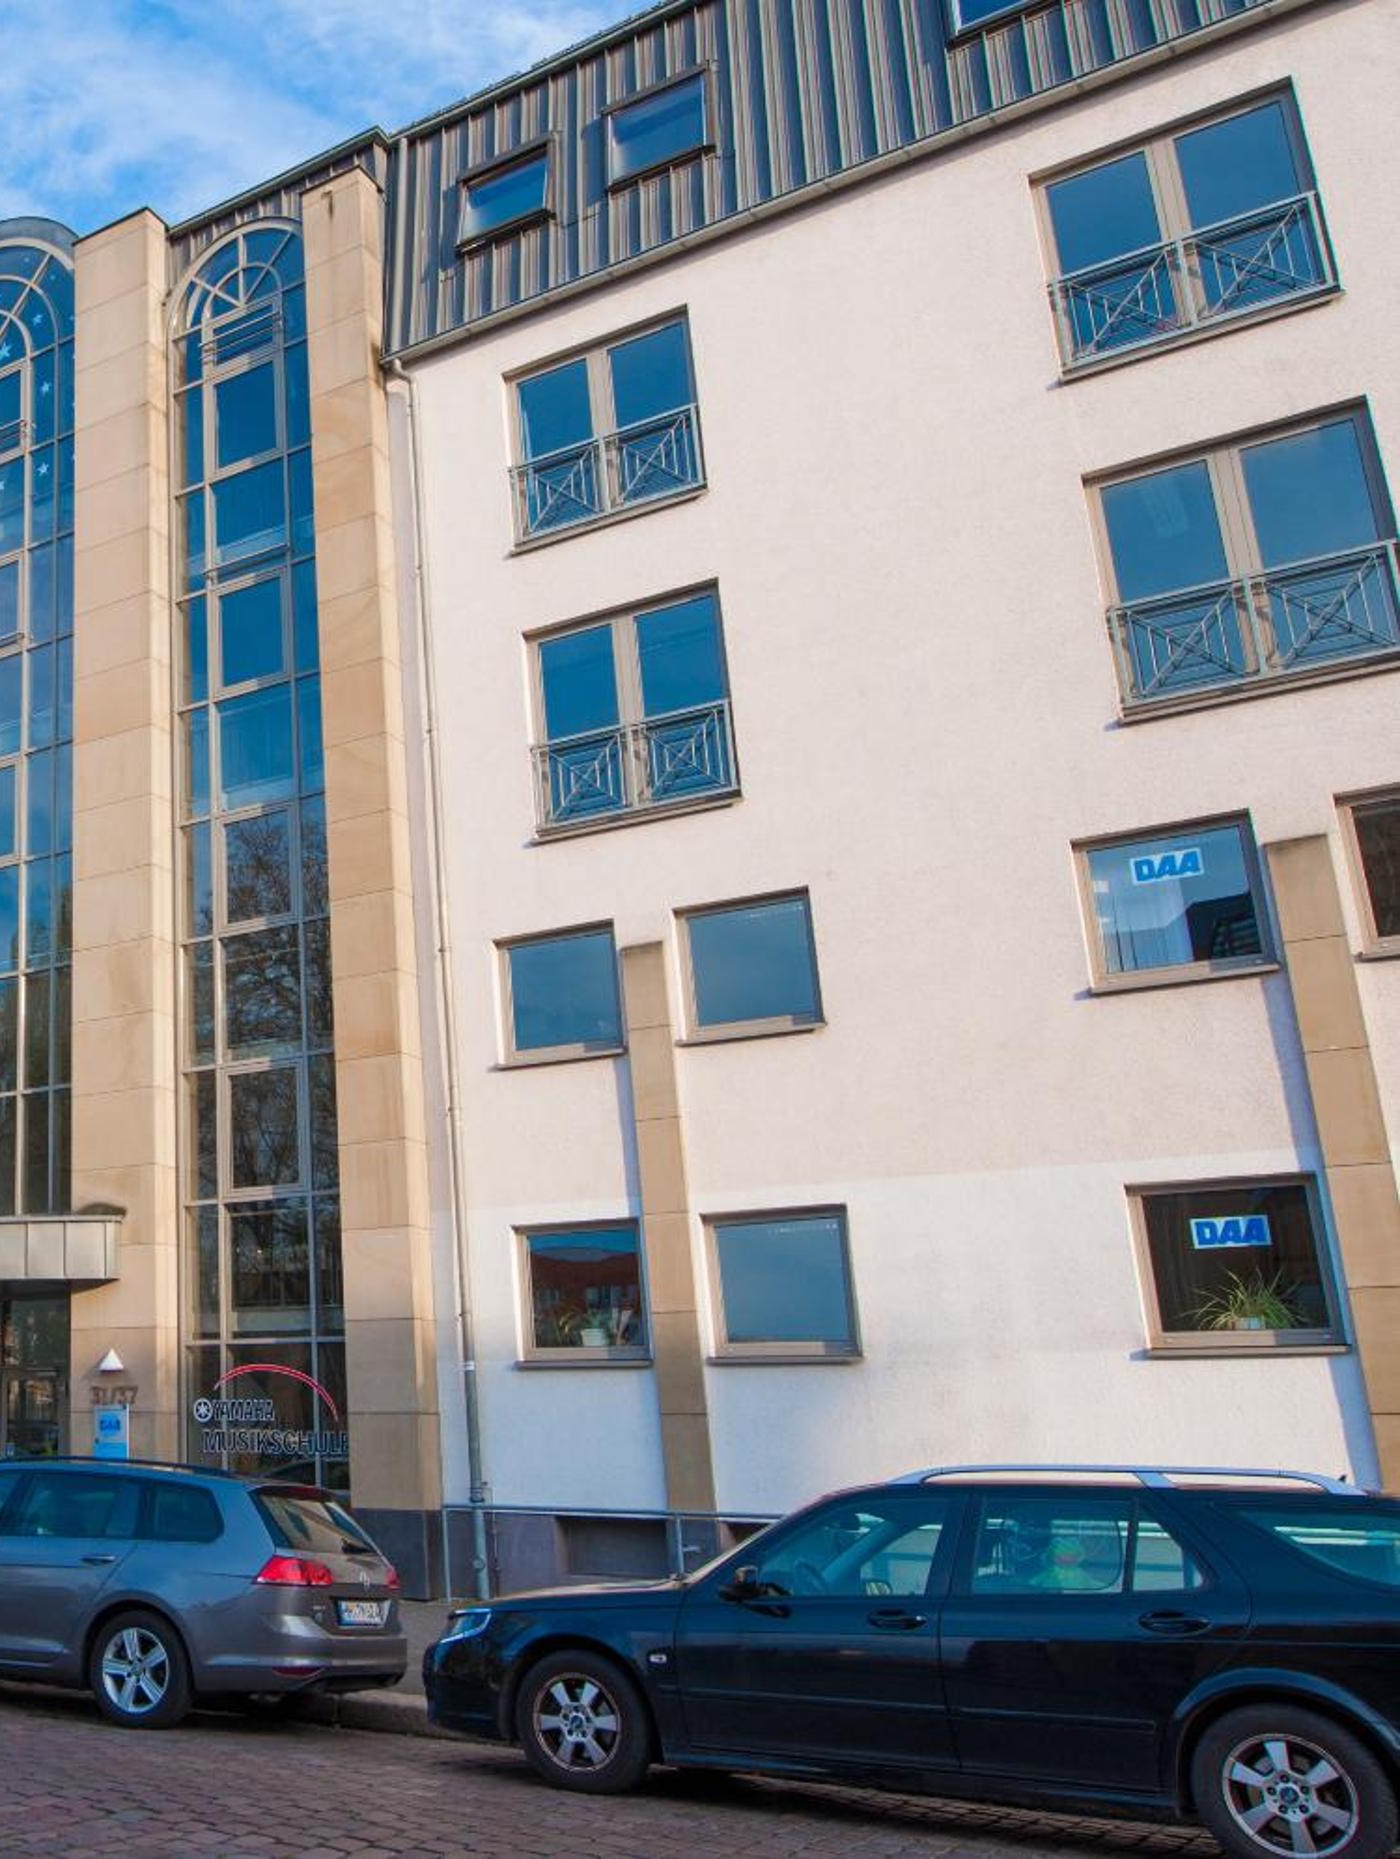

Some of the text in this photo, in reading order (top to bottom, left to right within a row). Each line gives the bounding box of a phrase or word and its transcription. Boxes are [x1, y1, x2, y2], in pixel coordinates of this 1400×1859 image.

[1133, 849, 1201, 883] DAA
[1194, 1219, 1270, 1246] DAA
[212, 1399, 275, 1422] YAMAHA
